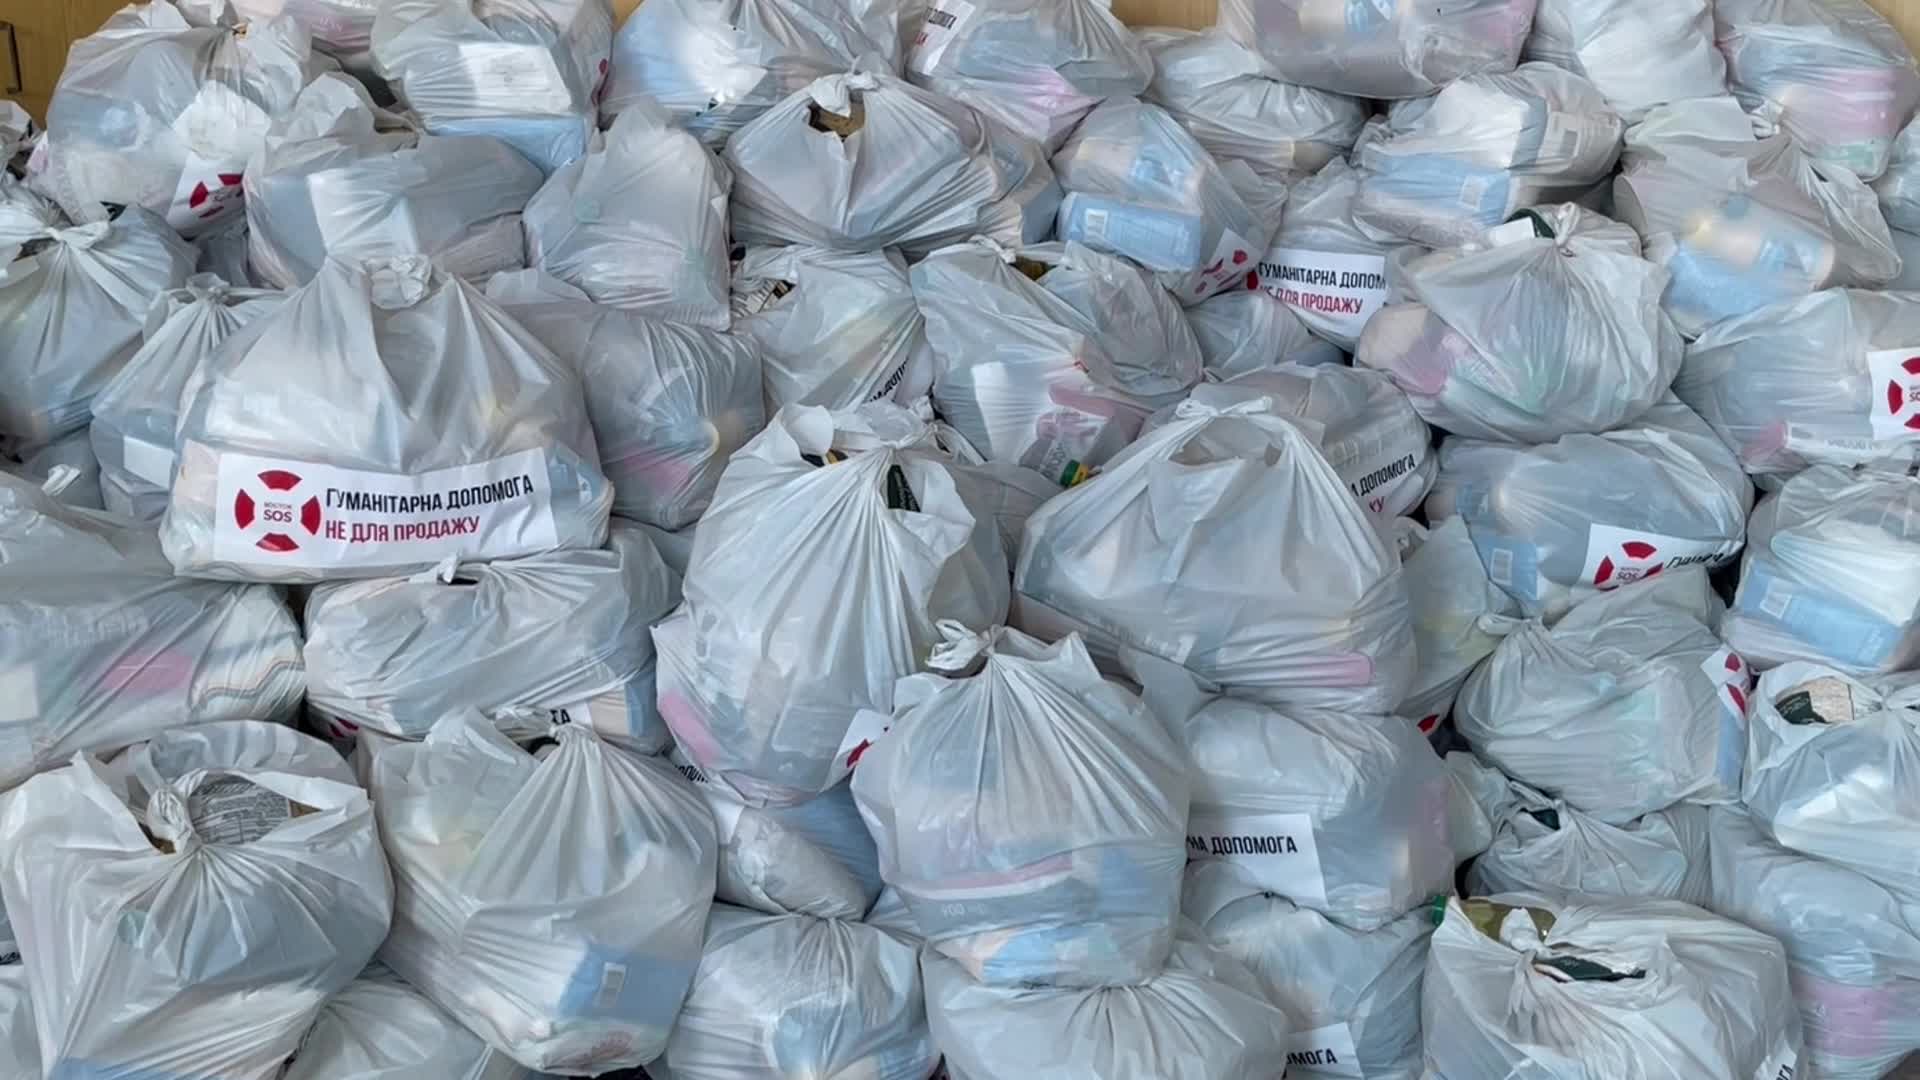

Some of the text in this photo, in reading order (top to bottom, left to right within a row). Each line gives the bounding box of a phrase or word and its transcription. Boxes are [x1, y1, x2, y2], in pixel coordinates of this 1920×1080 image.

[1259, 261, 1337, 287] ГУМАНІТАРНА
[1301, 291, 1364, 314] ПРОДАЖУ
[1360, 453, 1416, 497] ДОПОМОГА
[326, 474, 534, 514] ГУМАНІТАРНА ДОПОМОГА
[263, 509, 293, 523] SOS
[325, 515, 481, 543] НЕ ДЛЯ ПРОДАЖУ
[1211, 836, 1298, 855] ДОПОМОГА
